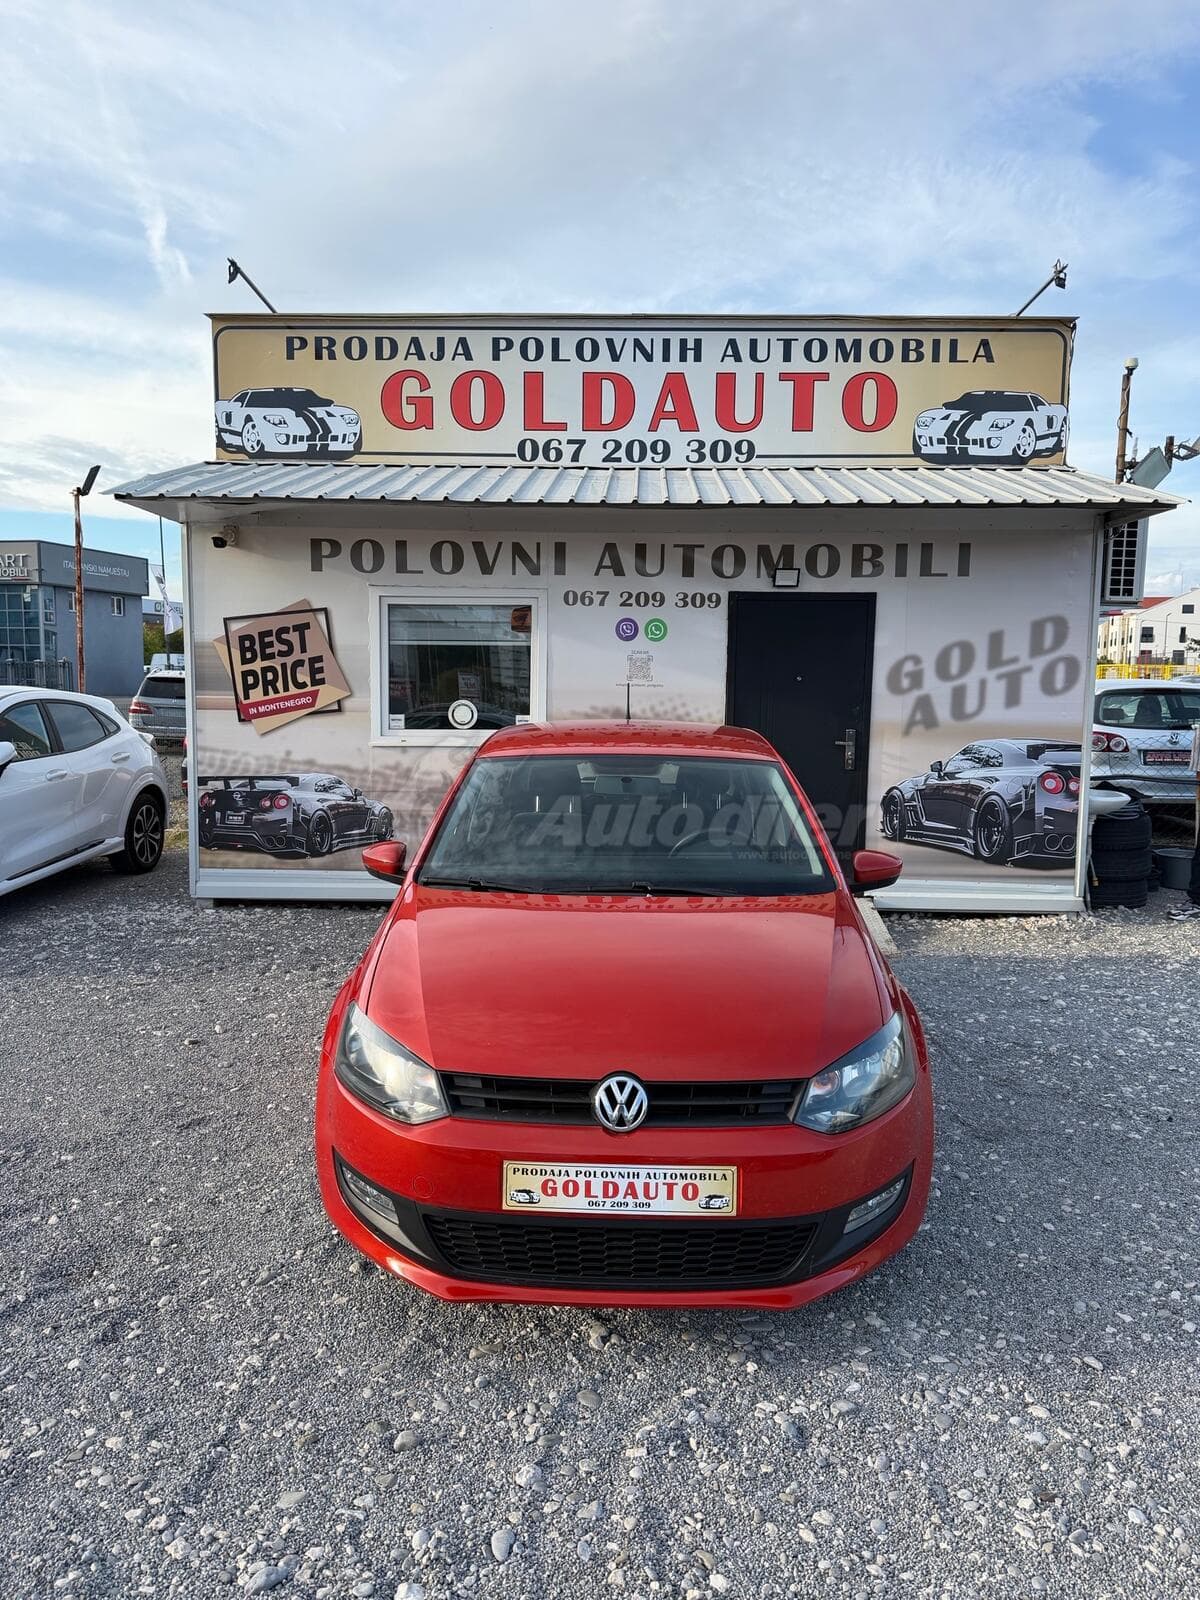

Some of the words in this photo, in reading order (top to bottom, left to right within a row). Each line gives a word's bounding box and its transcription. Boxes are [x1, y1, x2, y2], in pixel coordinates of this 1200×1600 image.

[285, 335, 474, 362] PRODAJA
[491, 336, 703, 363] POLOVNIH
[720, 337, 995, 364] AUTOMOBILA
[380, 369, 898, 433] GOLDAUTO
[516, 438, 586, 463] 067
[601, 438, 671, 464] 209
[685, 439, 757, 464] 309
[309, 537, 568, 577] POLOVNI
[594, 542, 973, 579] AUTOMOBILI
[0, 567, 28, 577] OBILI
[563, 589, 610, 608] 067
[619, 590, 666, 608] 209
[674, 591, 723, 609] 309
[238, 621, 311, 665] BEST
[886, 614, 1070, 696] GOLD
[240, 655, 326, 700] PRICE
[248, 706, 258, 715] IN
[258, 695, 313, 713] MONTENEGRO
[902, 653, 1081, 736] AUTO
[512, 1167, 570, 1178] PRODAJA
[575, 1169, 640, 1180] POLOVNIH
[645, 1171, 728, 1182] AUTOMOBILA
[540, 1178, 700, 1202] GOLDAUTO
[588, 1200, 608, 1208] 067
[610, 1200, 629, 1209] 209
[631, 1201, 651, 1209] 309
